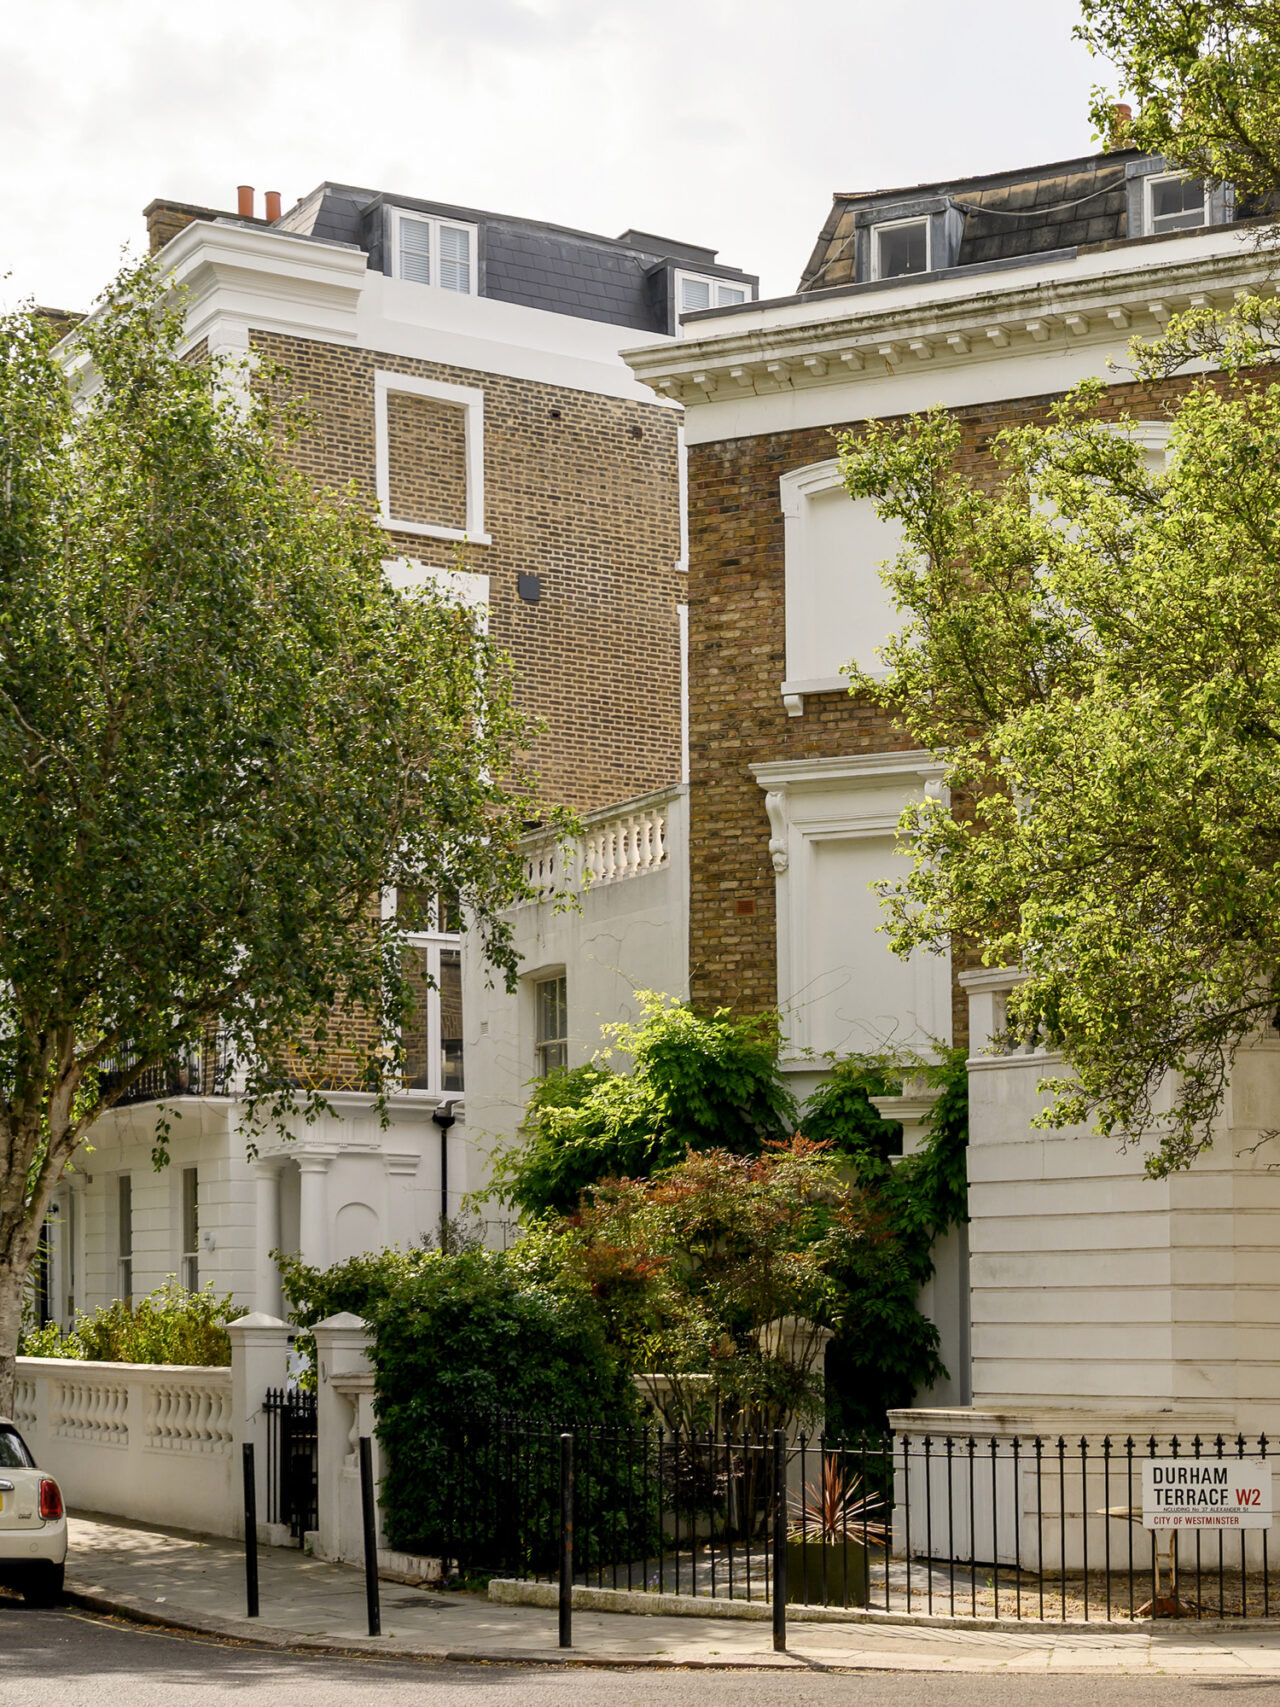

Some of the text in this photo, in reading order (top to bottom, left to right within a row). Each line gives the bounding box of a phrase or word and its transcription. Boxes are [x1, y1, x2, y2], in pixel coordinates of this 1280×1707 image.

[1153, 1467, 1228, 1484] DURHAM
[1154, 1488, 1261, 1506] TERRACE W2
[1153, 1516, 1240, 1525] CITY OF WESTMINSTER
